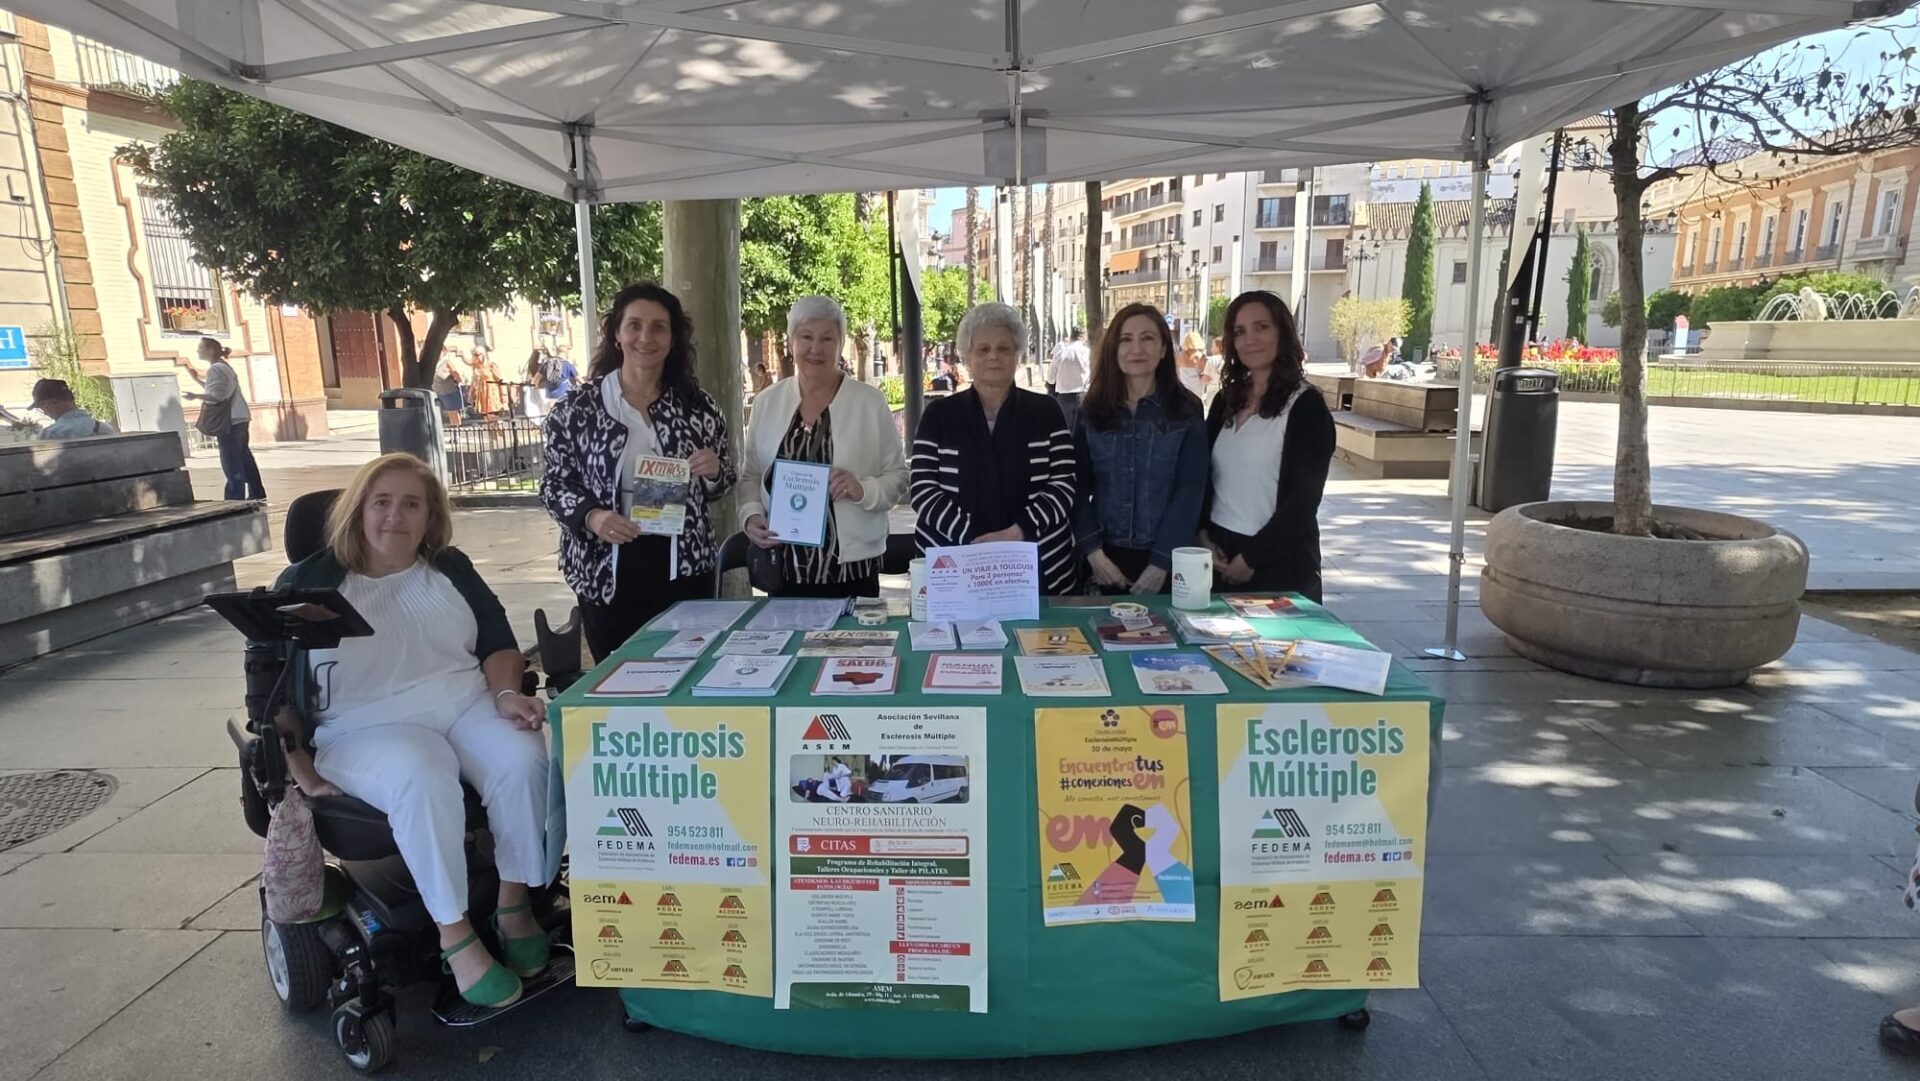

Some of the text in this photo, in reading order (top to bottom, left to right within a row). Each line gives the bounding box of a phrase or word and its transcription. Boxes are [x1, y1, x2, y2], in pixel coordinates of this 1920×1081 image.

[974, 565, 991, 573] VIAJE
[591, 722, 745, 759] Esclerosis
[924, 732, 956, 741] Múltiple
[1247, 719, 1404, 756] Esclerosis
[593, 762, 717, 805] Múltiple
[1249, 760, 1377, 803] Múltiple
[826, 806, 933, 816] CENTRO SANITARIO
[812, 816, 946, 827] NEURO-REHABILITACIÓN
[667, 826, 724, 838] 954 523 811
[1325, 822, 1382, 836] 954 523 811
[597, 840, 655, 851] FEDEMA
[820, 840, 857, 851] CITAS
[1251, 842, 1311, 853] FEDEMA
[668, 853, 720, 867] fedema.es
[1324, 851, 1376, 864] fedema.es
[919, 867, 949, 875] PILATES
[1047, 883, 1083, 891] FEDEMA
